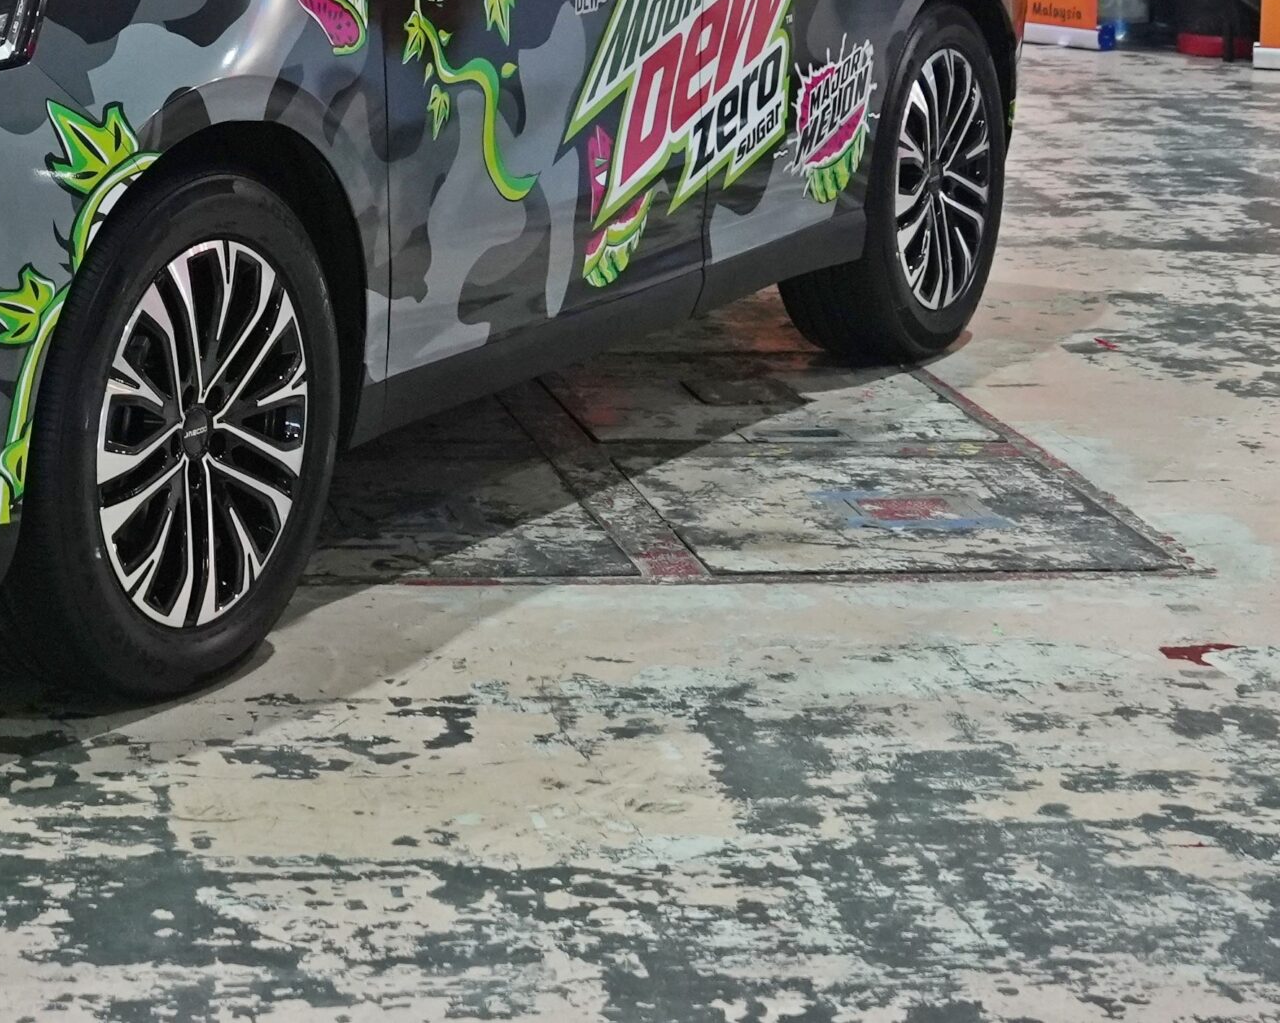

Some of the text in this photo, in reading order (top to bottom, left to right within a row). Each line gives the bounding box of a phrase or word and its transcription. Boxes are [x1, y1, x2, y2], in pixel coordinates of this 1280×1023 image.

[1033, 1, 1082, 22] Malaysia
[809, 48, 863, 117] MAJOR
[793, 63, 871, 170] MELON
[183, 425, 208, 439] JAECOO
